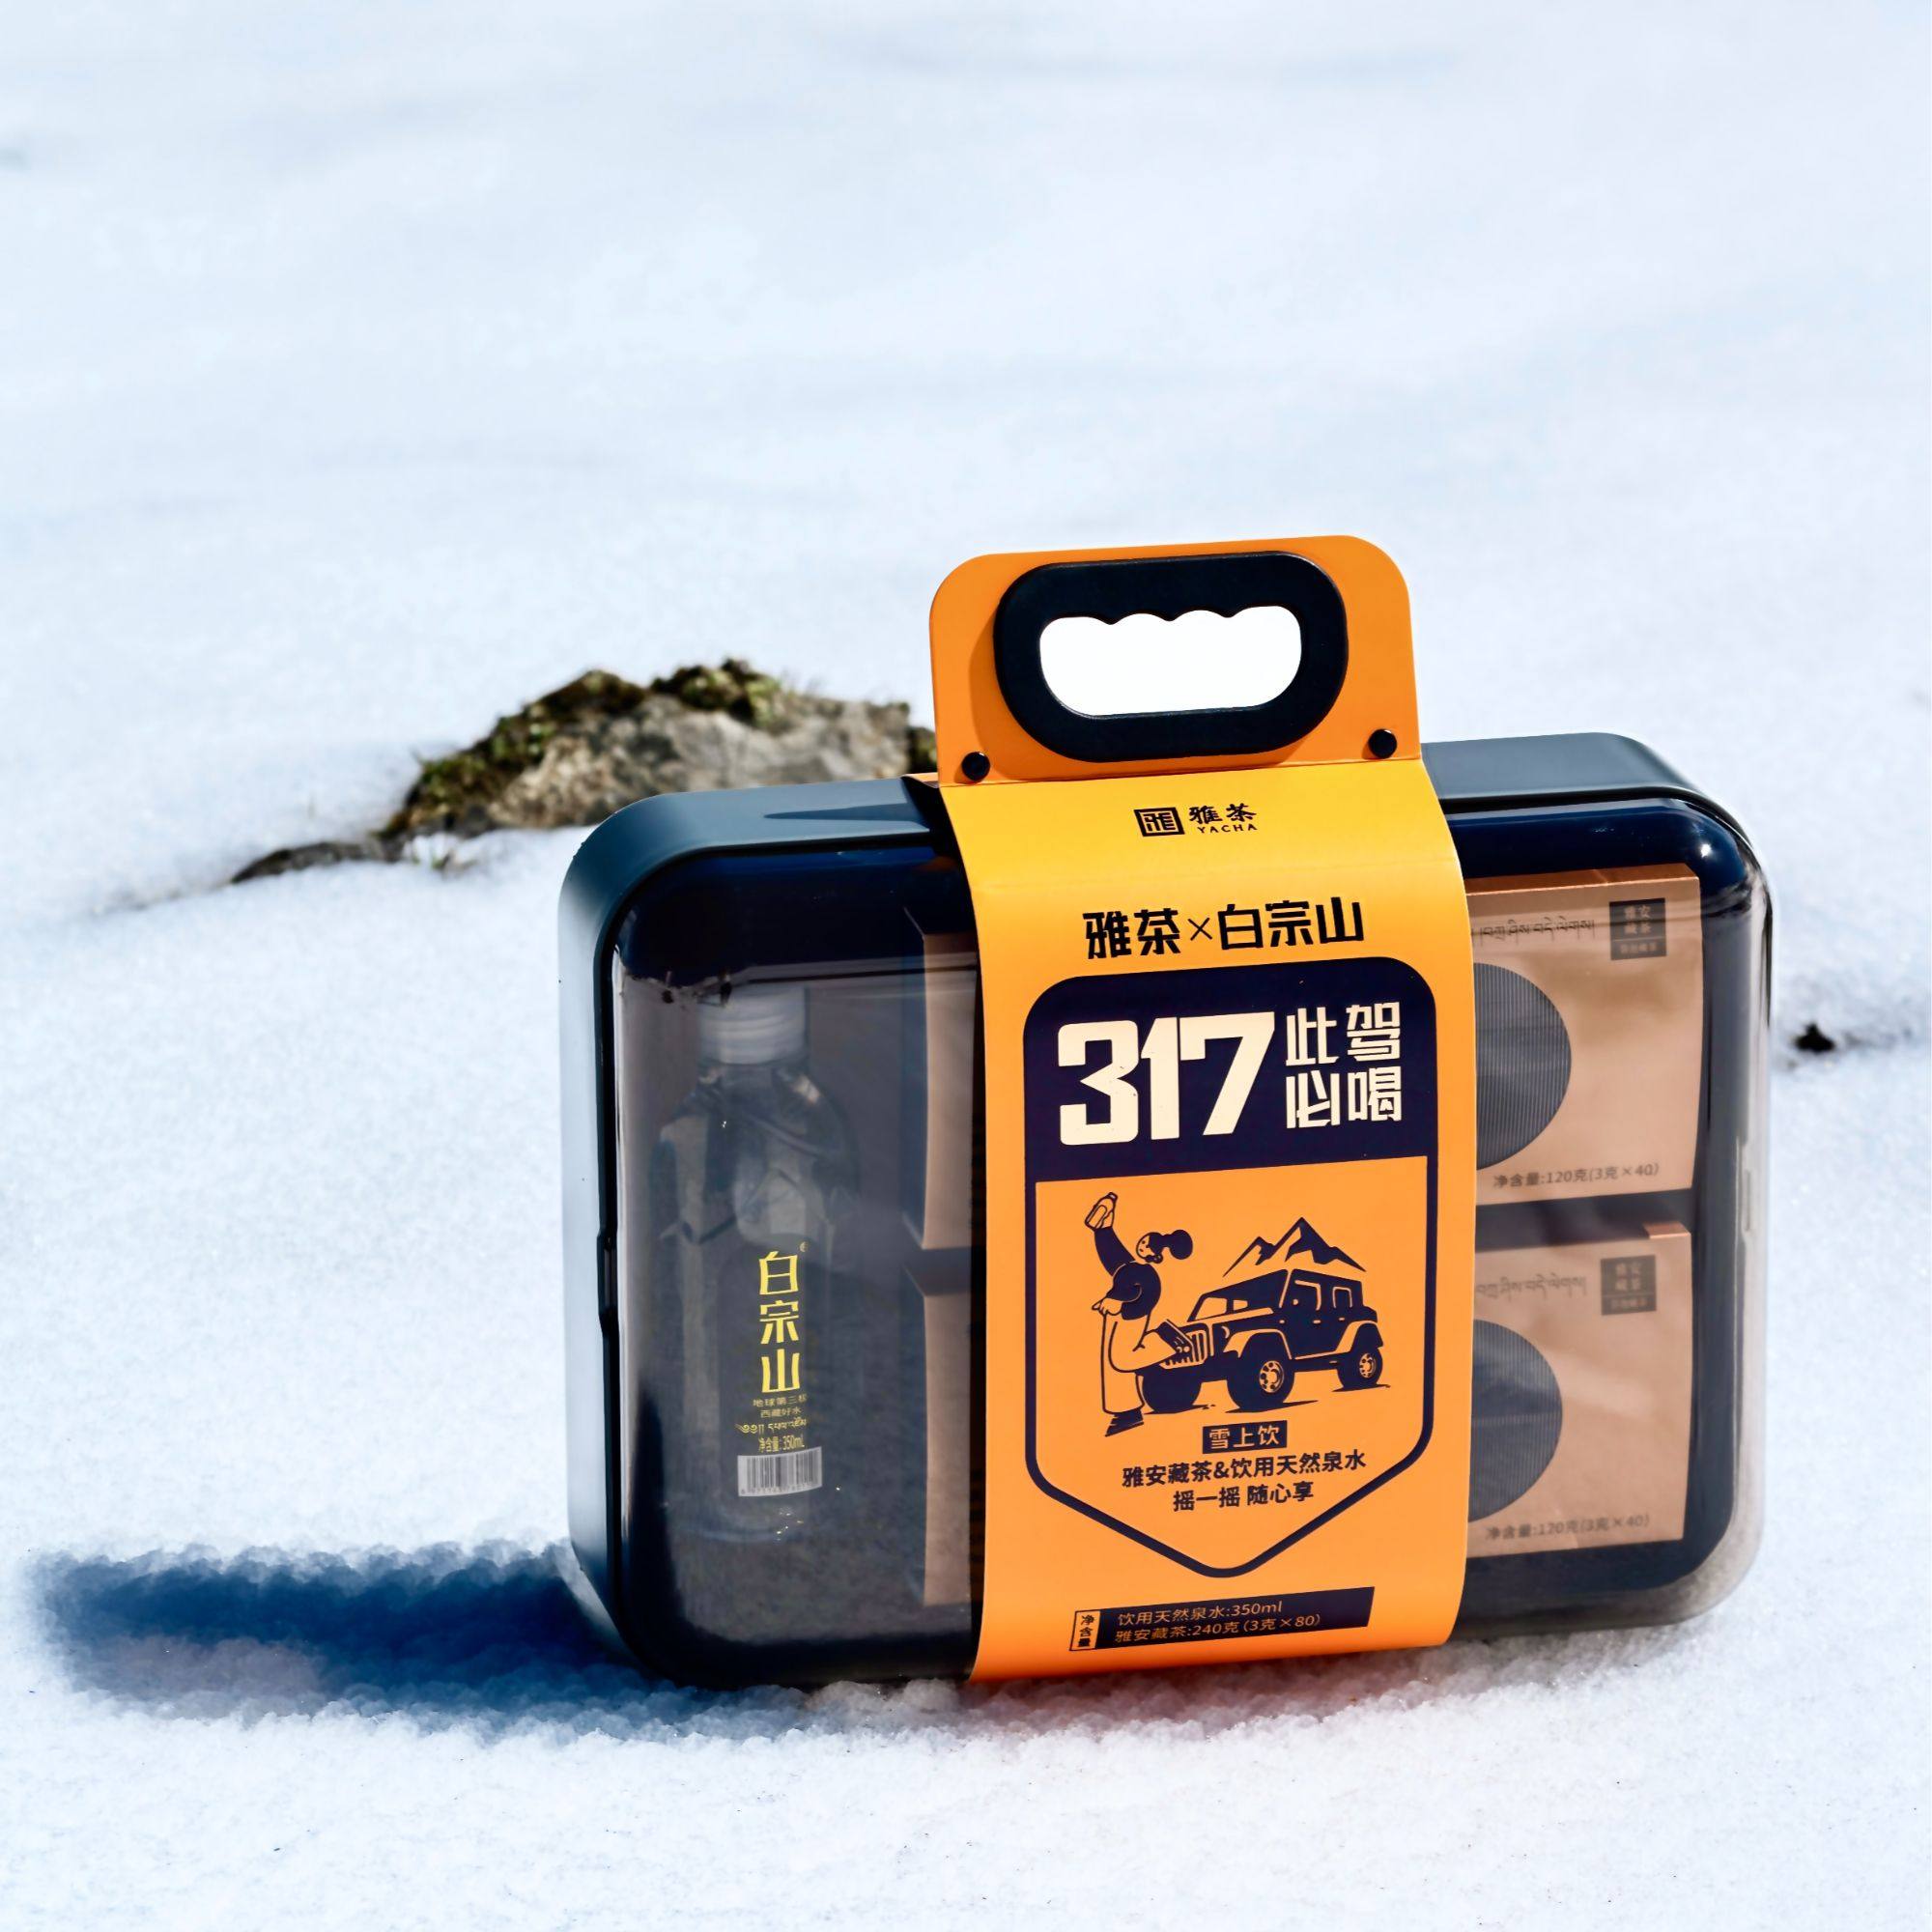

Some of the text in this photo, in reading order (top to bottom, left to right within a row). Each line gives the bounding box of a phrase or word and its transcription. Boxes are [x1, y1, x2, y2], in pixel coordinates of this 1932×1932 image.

[1189, 803, 1258, 824] 雅茶
[1197, 823, 1258, 834] YACHA
[1082, 895, 1365, 960] 雅茶×白宗山
[1057, 1010, 1276, 1146] 317
[758, 1251, 801, 1393] 白宗山
[1208, 1424, 1281, 1450] 雪上饮
[1121, 1449, 1367, 1489] 雅安藏茶&饮用天然泉水
[1172, 1480, 1315, 1513] 摇一摇 随心享
